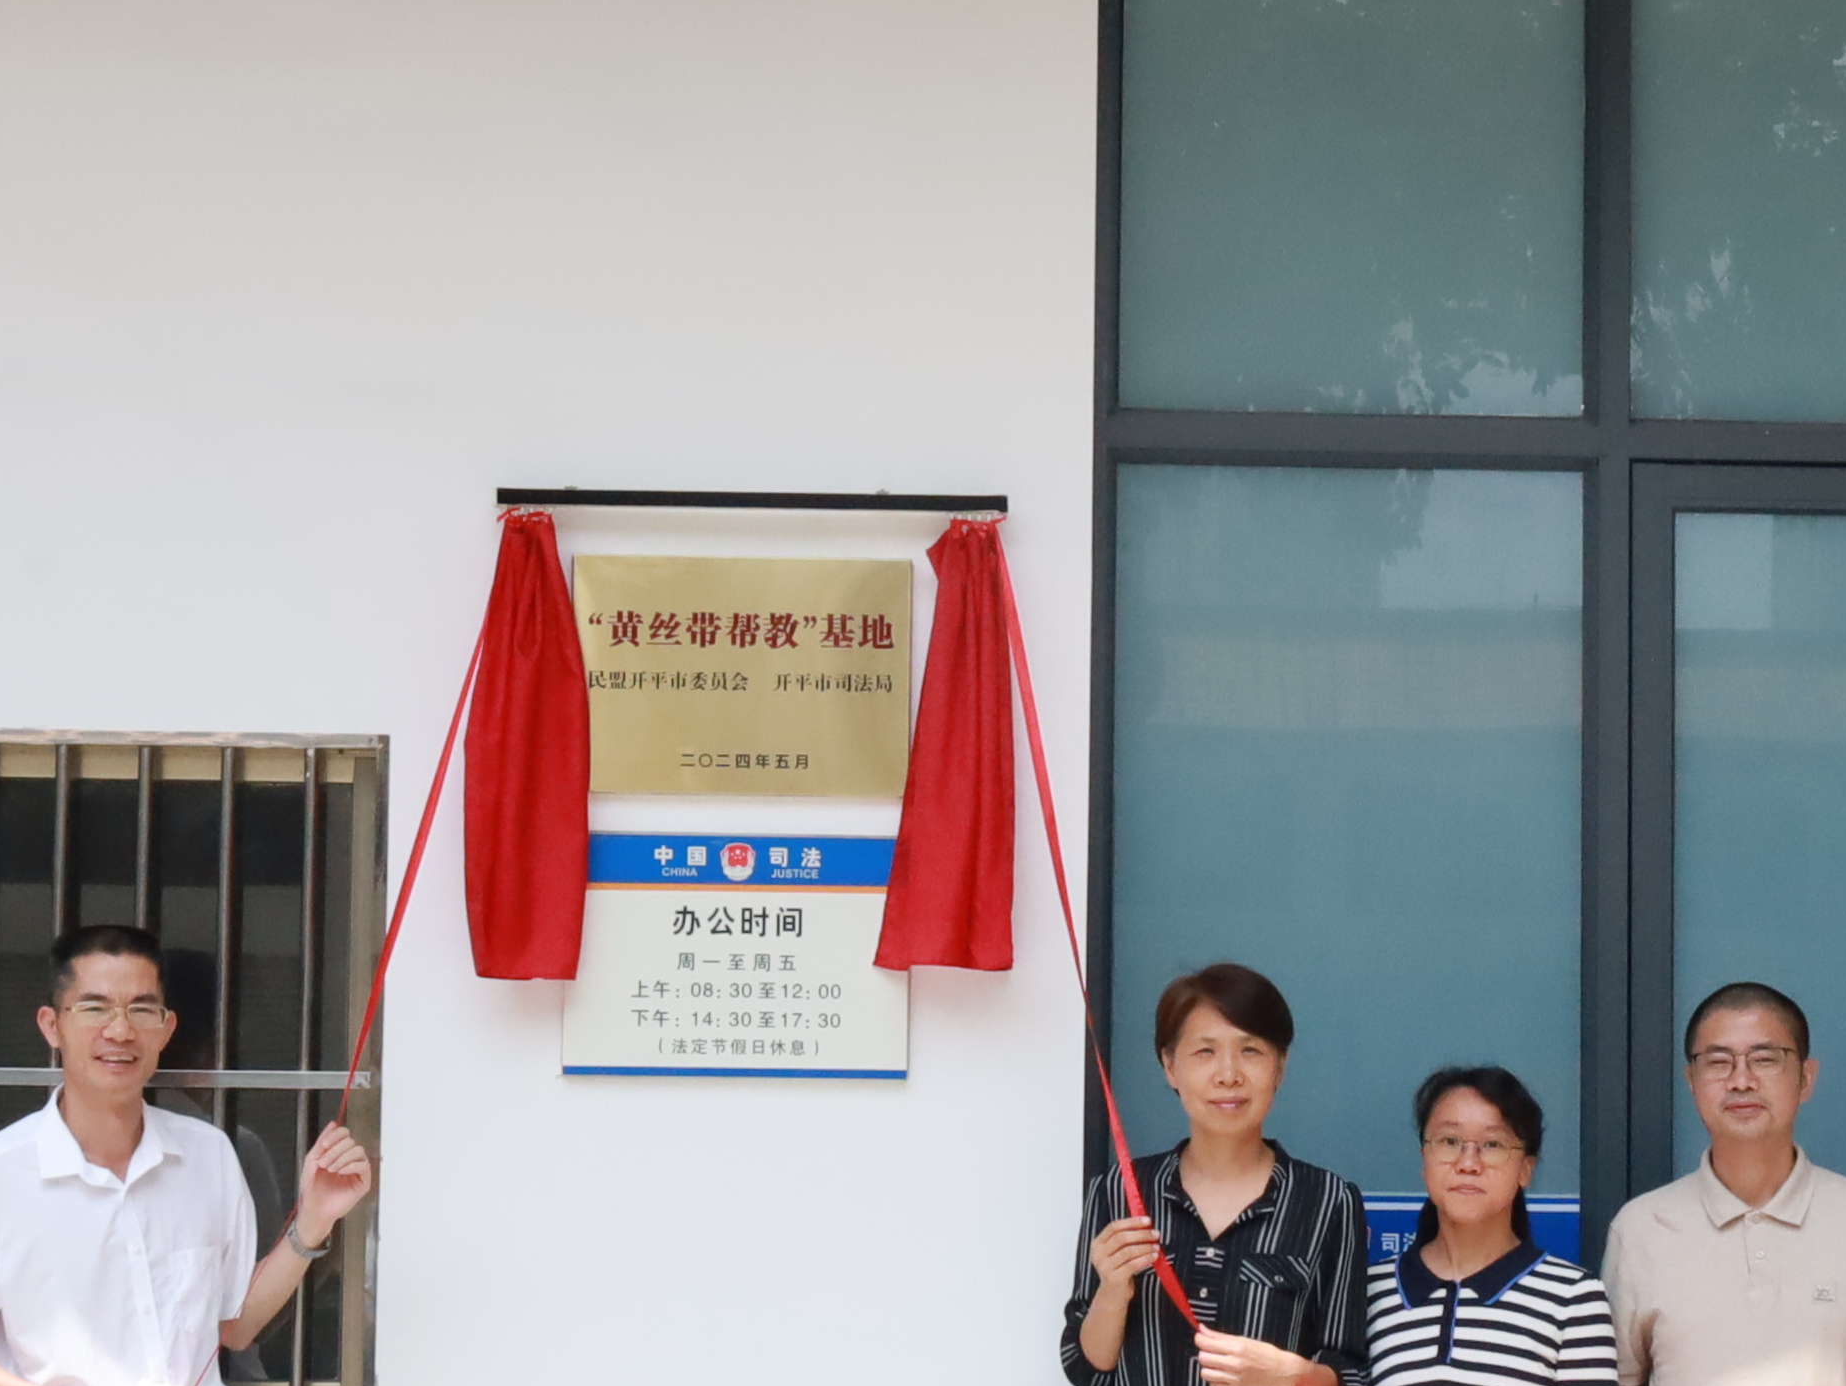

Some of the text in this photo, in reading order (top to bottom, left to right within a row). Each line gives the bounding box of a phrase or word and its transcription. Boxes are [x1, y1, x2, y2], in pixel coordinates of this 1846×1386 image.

[588, 610, 895, 649] “黄丝带帮教”基地
[588, 669, 893, 694] 民盟开平市委员会 开平市司法局
[654, 845, 821, 868] 中国 司法
[662, 867, 820, 879] CHINA JUSTICE
[673, 905, 803, 938] 办公时间
[677, 952, 796, 972] 周一至周五
